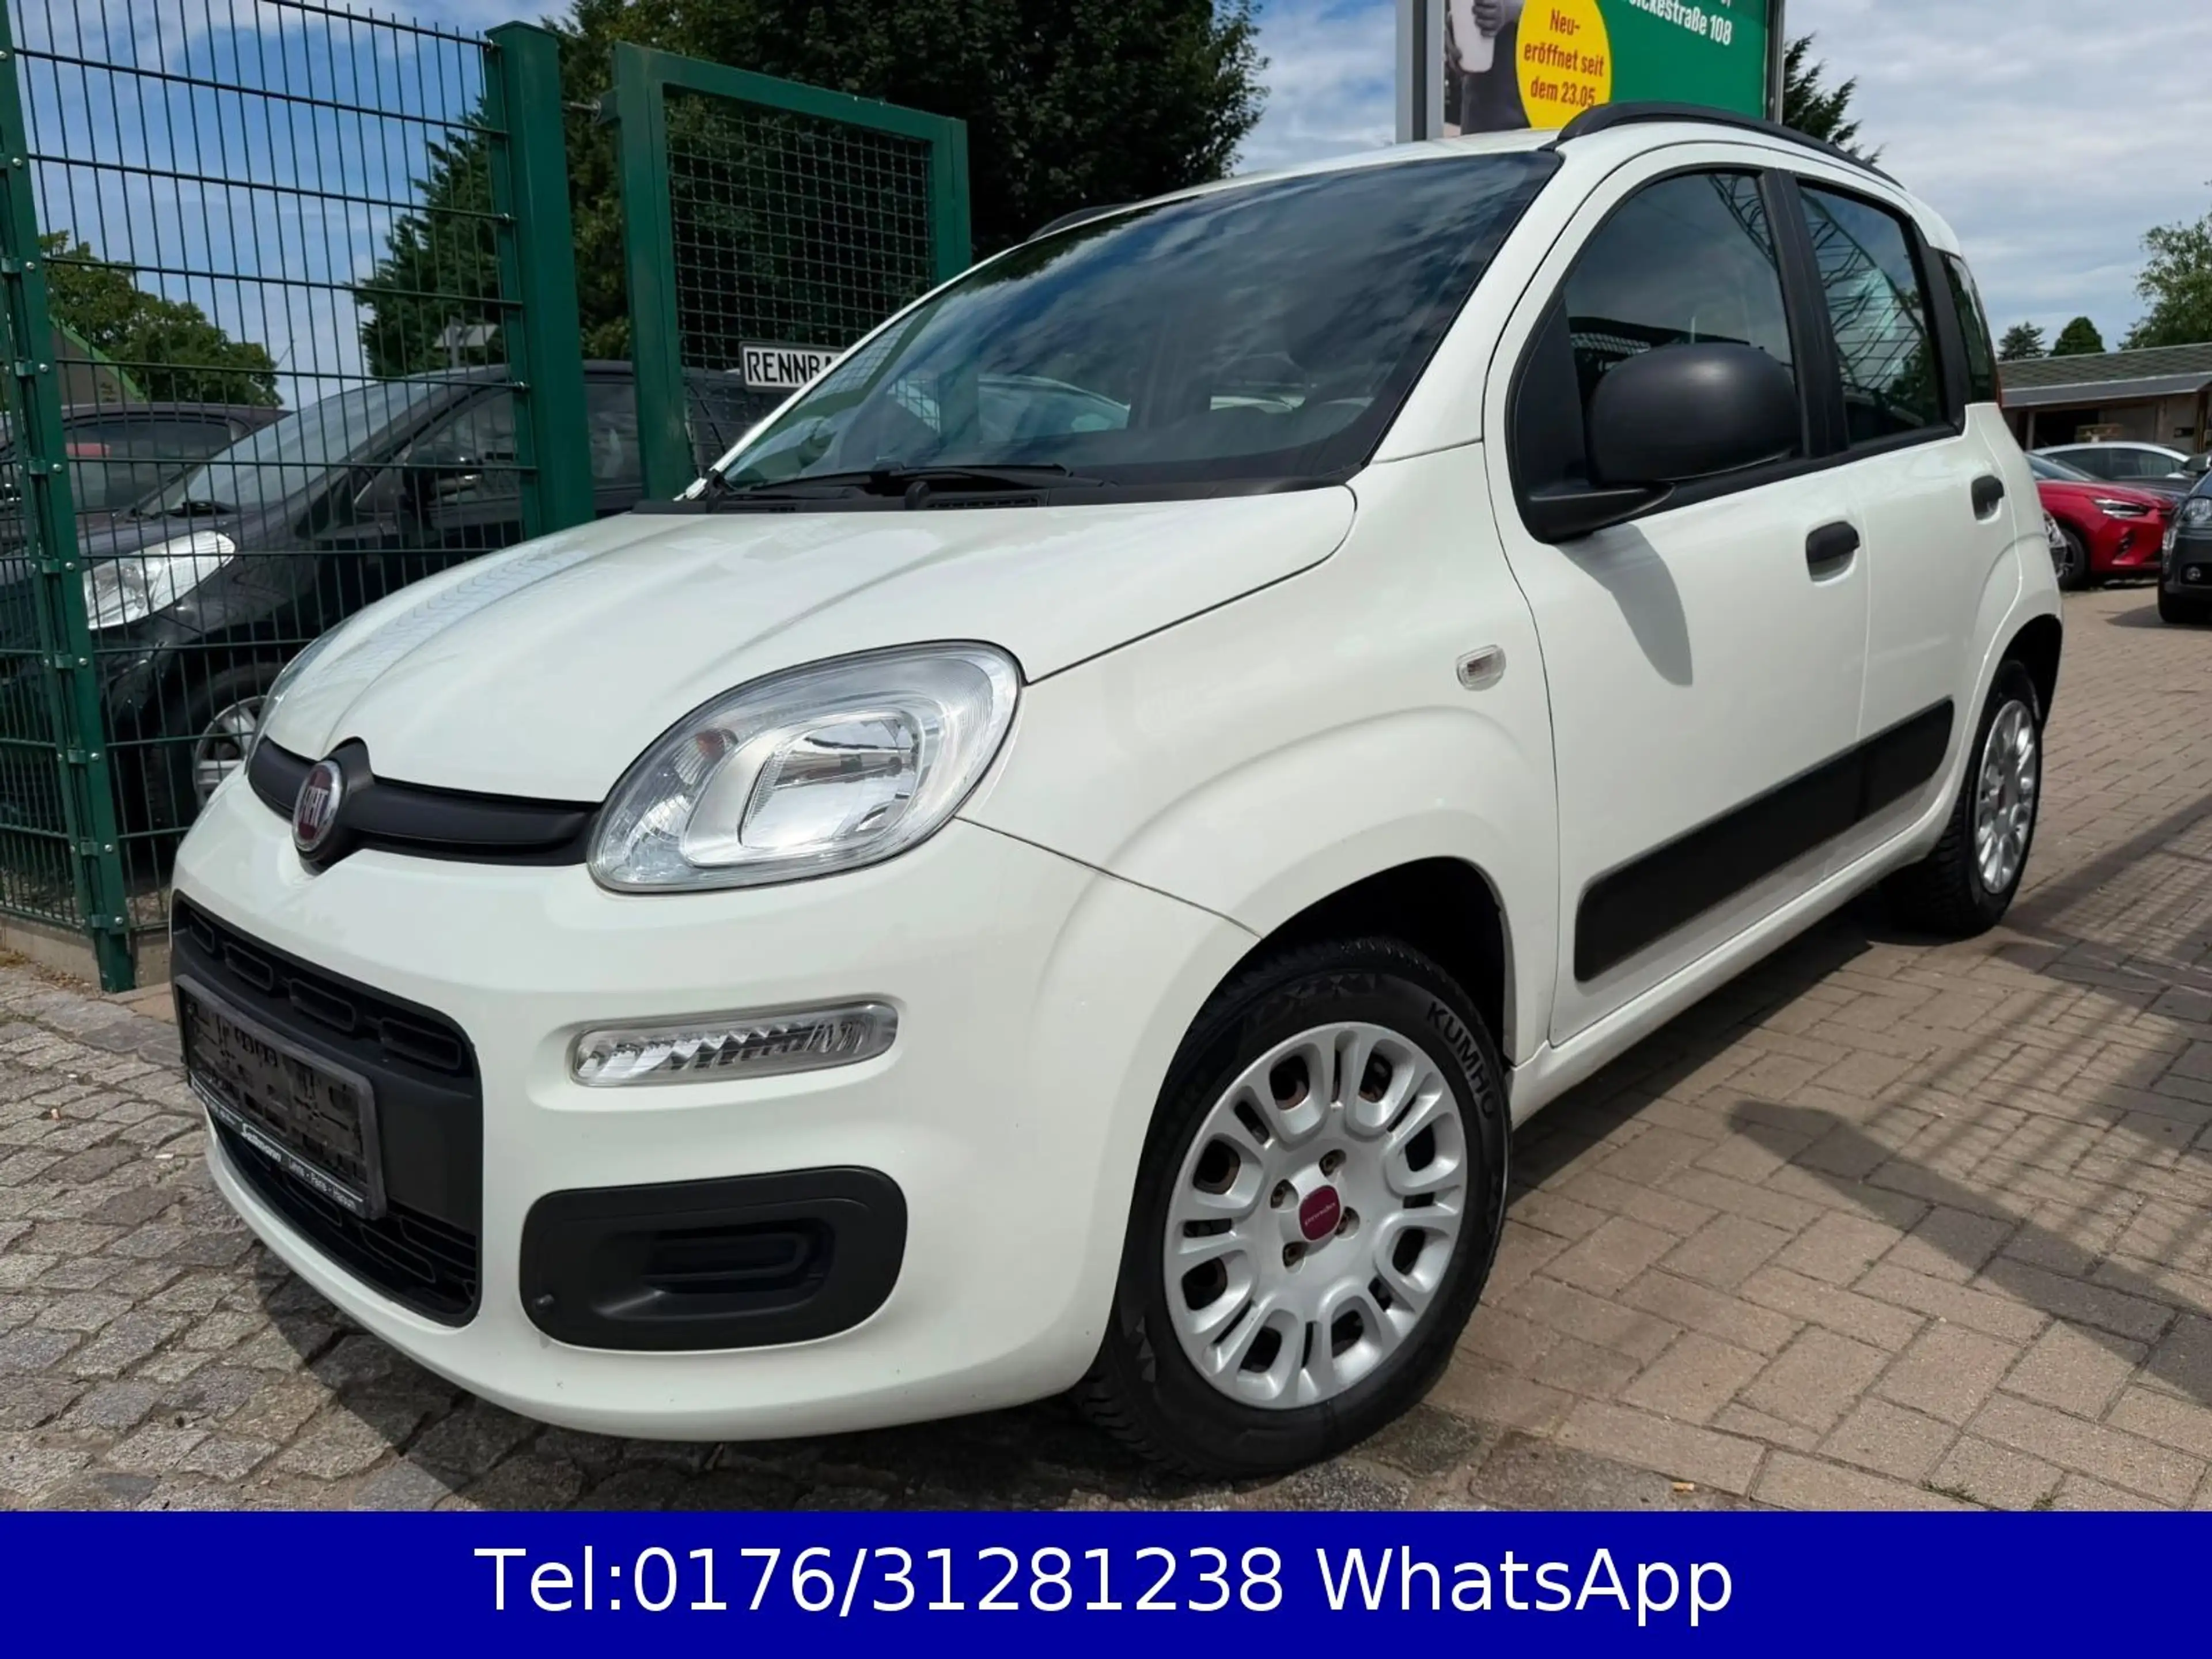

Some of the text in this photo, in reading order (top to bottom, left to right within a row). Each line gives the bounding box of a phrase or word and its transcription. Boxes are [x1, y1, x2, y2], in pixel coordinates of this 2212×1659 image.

[1550, 9, 1580, 36] Neu-
[1710, 14, 1732, 46] 108
[1524, 43, 1604, 77] eröffnet seit
[1531, 76, 1558, 101] dem
[300, 787, 329, 827] FIAT
[1427, 1001, 1495, 1119] KUMHO
